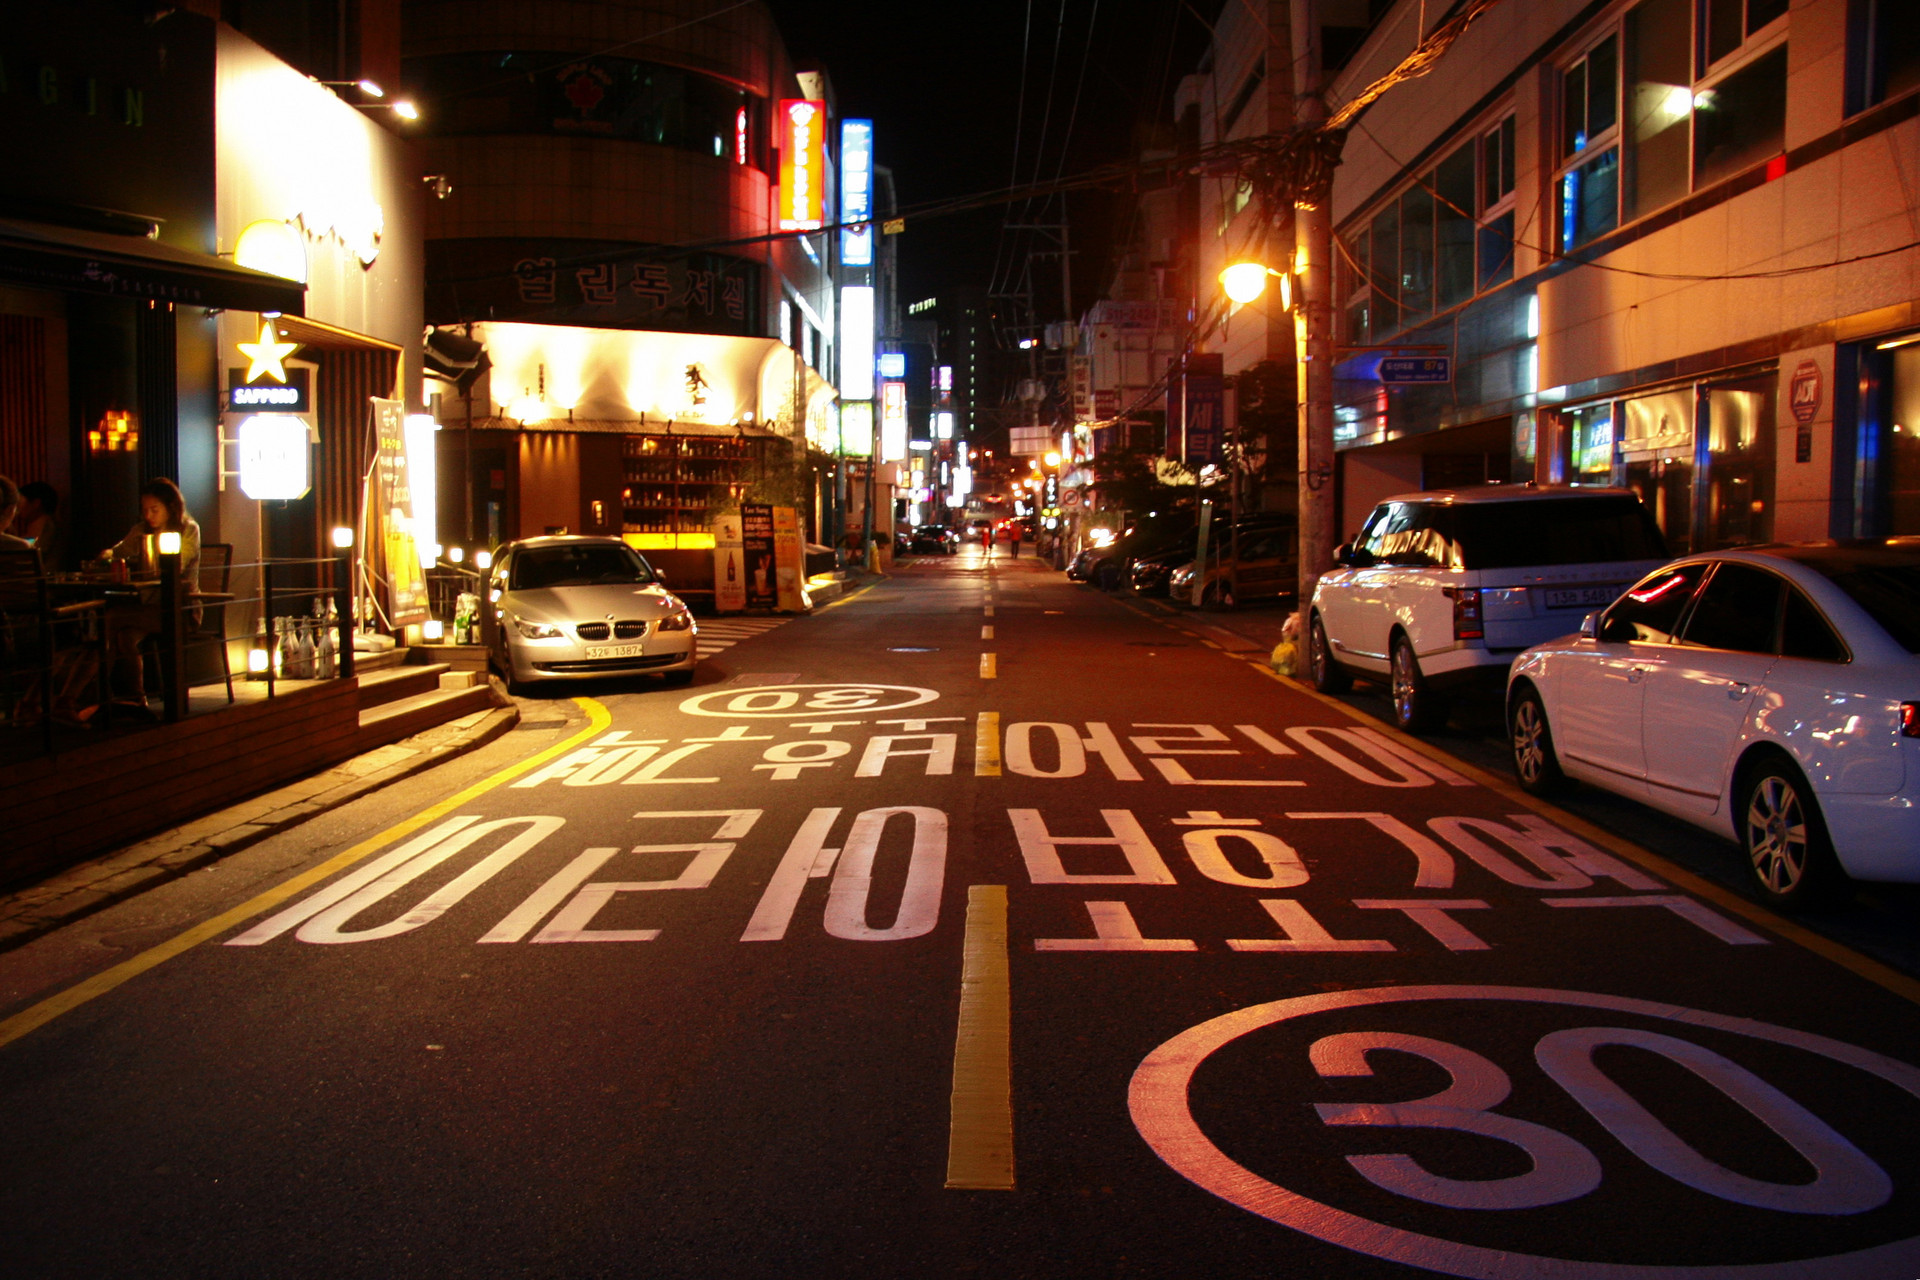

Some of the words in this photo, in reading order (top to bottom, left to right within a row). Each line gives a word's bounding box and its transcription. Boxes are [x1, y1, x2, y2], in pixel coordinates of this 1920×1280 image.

[513, 257, 745, 320] 열린독서실
[234, 388, 298, 404] SAPPORO
[1794, 379, 1818, 404] ADT
[1583, 589, 1614, 603] 5481
[615, 646, 638, 656] 1387
[727, 687, 887, 713] 30
[1003, 721, 1478, 788] 어린이
[1006, 808, 1774, 953] 보호구역
[1308, 1026, 1894, 1215] 30
